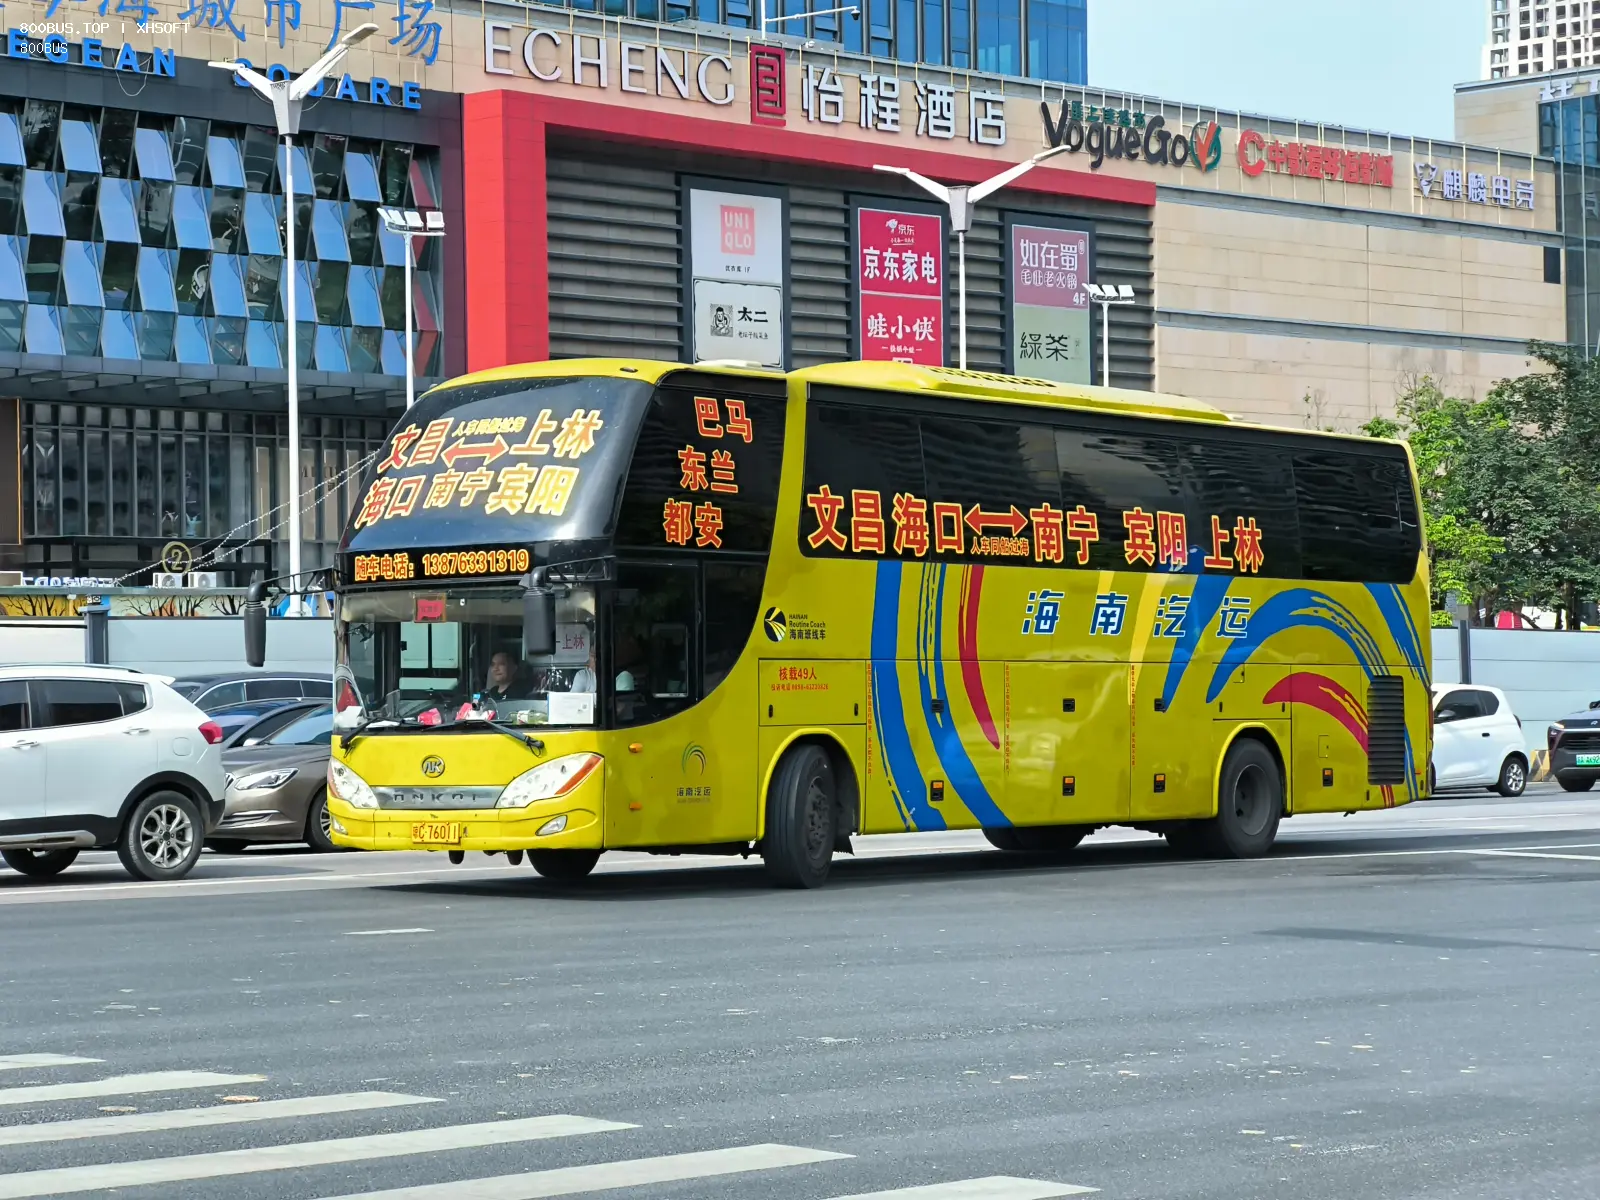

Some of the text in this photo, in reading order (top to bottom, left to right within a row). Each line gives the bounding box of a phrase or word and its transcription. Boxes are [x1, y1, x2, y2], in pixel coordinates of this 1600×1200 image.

[484, 20, 735, 105] ECHENG
[802, 64, 1006, 146] 怡程酒店
[1040, 98, 1189, 169] VogueGo
[724, 211, 750, 230] UNI
[898, 223, 915, 236] 京东
[724, 233, 752, 250] QLO
[1020, 238, 1078, 271] 如在蜀
[863, 246, 937, 284] 京东家电
[1021, 269, 1077, 290] 毛肚老火锅
[1073, 292, 1086, 306] 4F
[737, 306, 769, 323] 太二
[867, 312, 936, 341] 蛙小侠
[694, 396, 753, 443] 巴马
[377, 408, 603, 474] 文昌 上林
[678, 444, 738, 493] 东兰
[663, 498, 723, 548] 都安
[807, 484, 1265, 574] 文昌海口 南宁 宾阳 上林
[970, 535, 1030, 556] 人车同船过海
[172, 549, 183, 571] 2
[422, 549, 529, 576] 13876331319
[788, 620, 810, 628] Routine
[1022, 589, 1252, 638] 海南汽运
[789, 629, 826, 640] 海南班线车
[779, 666, 818, 681] 核载49人
